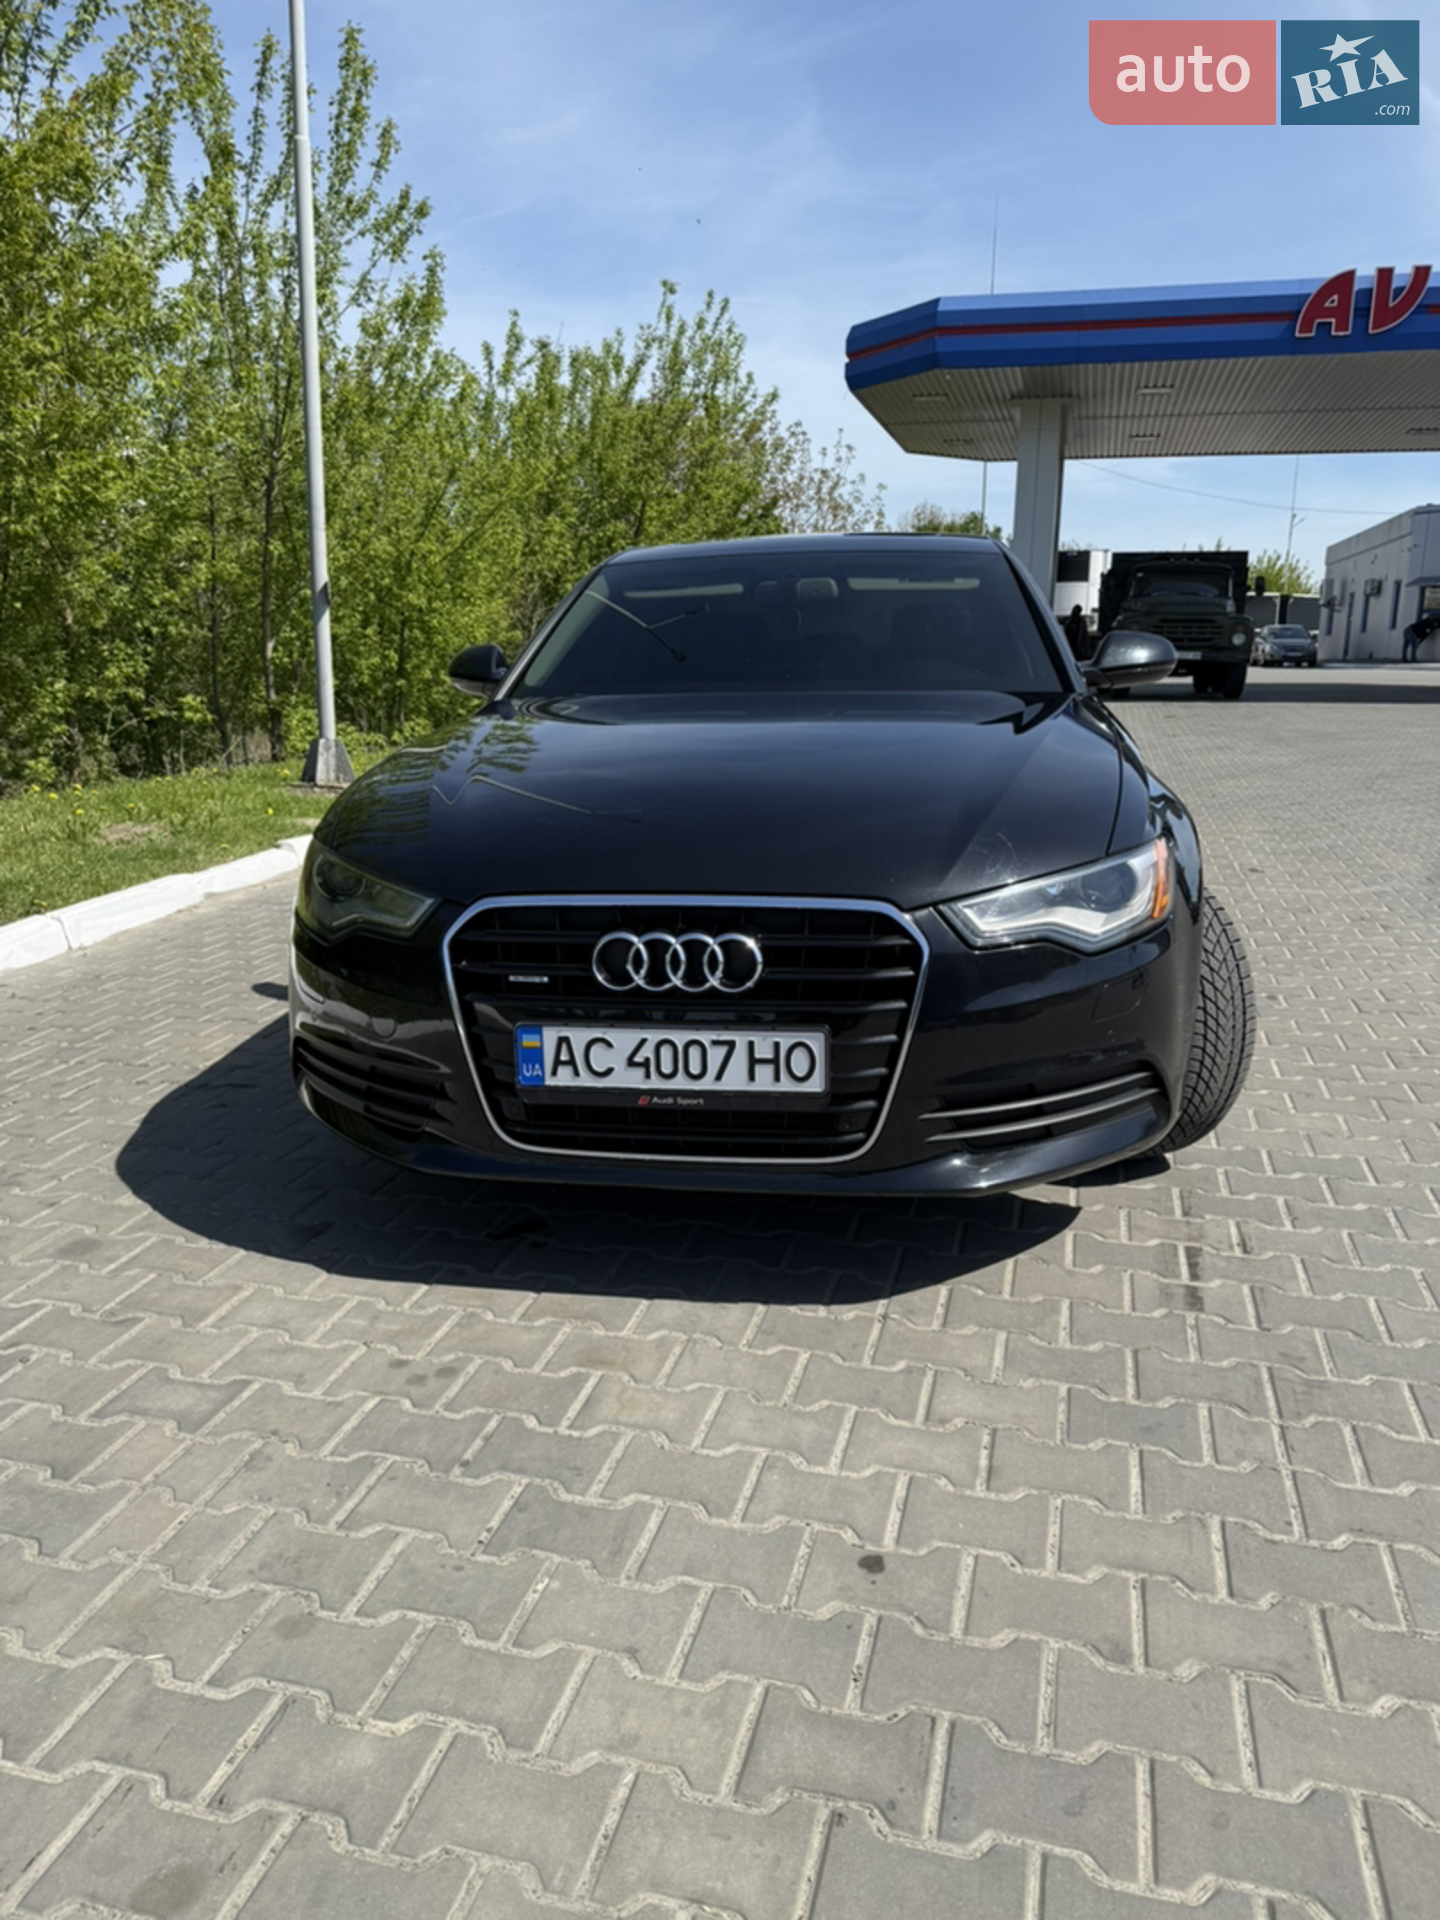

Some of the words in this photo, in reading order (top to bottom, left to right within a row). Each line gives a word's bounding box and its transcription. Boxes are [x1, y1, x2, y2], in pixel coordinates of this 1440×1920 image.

[1295, 264, 1433, 338] AV
[522, 1063, 543, 1077] UA
[551, 1036, 616, 1078] AC
[626, 1037, 737, 1081] 4007
[748, 1040, 817, 1083] HO
[652, 1096, 674, 1105] Audi
[676, 1096, 704, 1106] Sport
